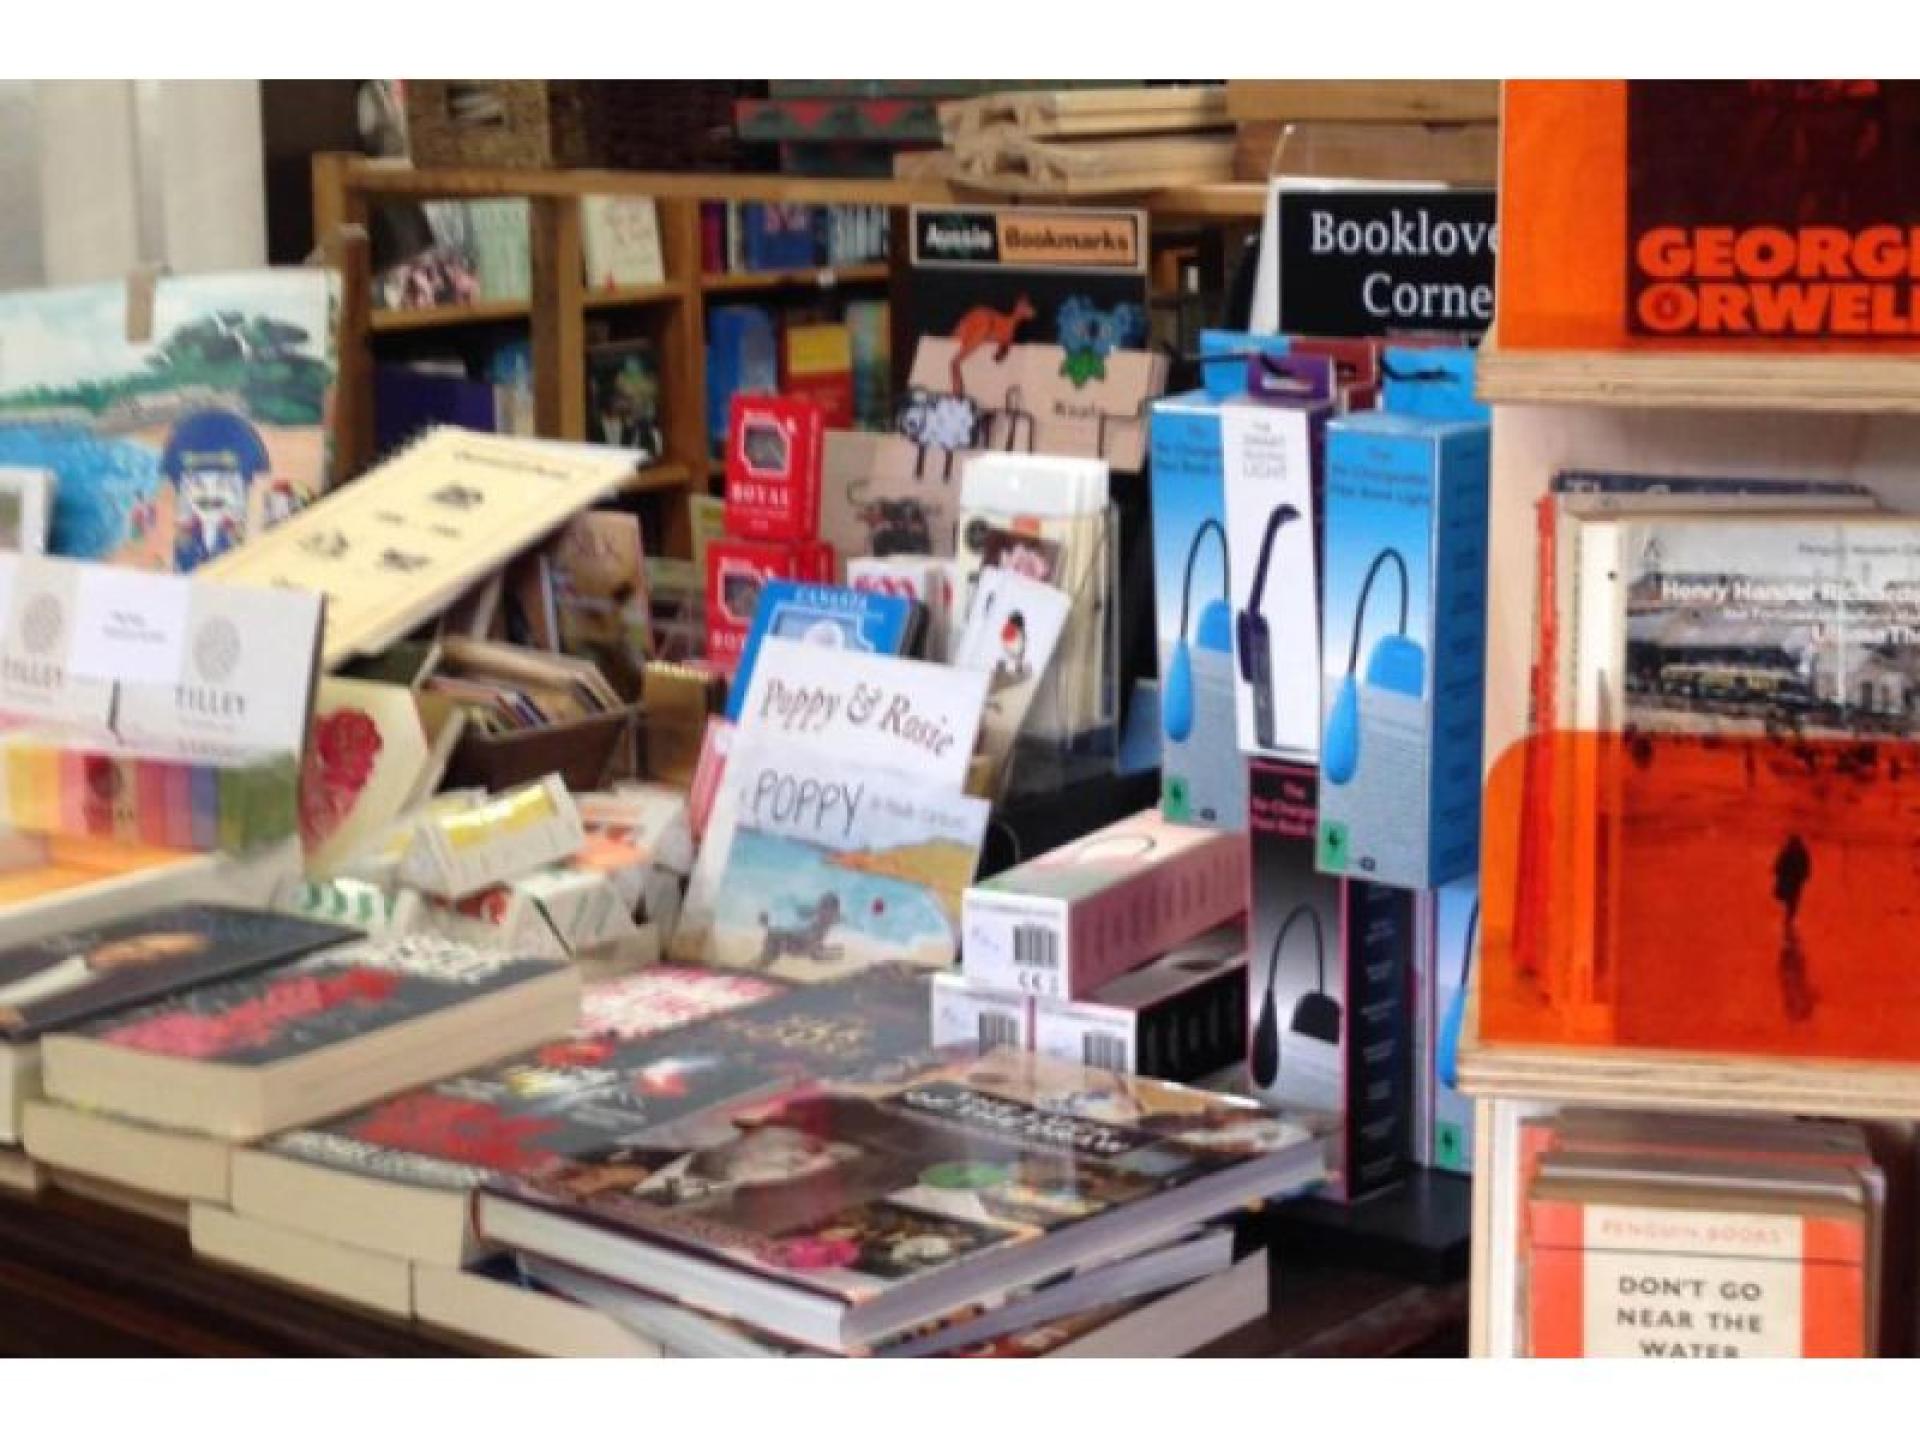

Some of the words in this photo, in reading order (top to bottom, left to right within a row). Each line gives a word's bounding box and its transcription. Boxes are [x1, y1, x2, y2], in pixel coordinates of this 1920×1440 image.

[1004, 225, 1130, 250] Bookmarks
[1638, 226, 1920, 277] GEORG
[1638, 282, 1920, 333] ORWEL
[731, 482, 789, 505] ROYAL
[1663, 579, 1727, 605] Henry
[175, 684, 246, 715] TILLEY
[762, 679, 839, 732] Poppy
[847, 682, 882, 724] &
[880, 693, 953, 756] Rosie
[754, 767, 864, 837] POPPY
[1602, 1219, 1701, 1240] PENGUIN
[1707, 1226, 1783, 1245] BOOKS
[1617, 1275, 1707, 1299] DON'T
[1719, 1280, 1762, 1302] GO
[1616, 1306, 1693, 1330] NEAR
[1707, 1311, 1763, 1334] THE
[1639, 1340, 1740, 1358] WATER
